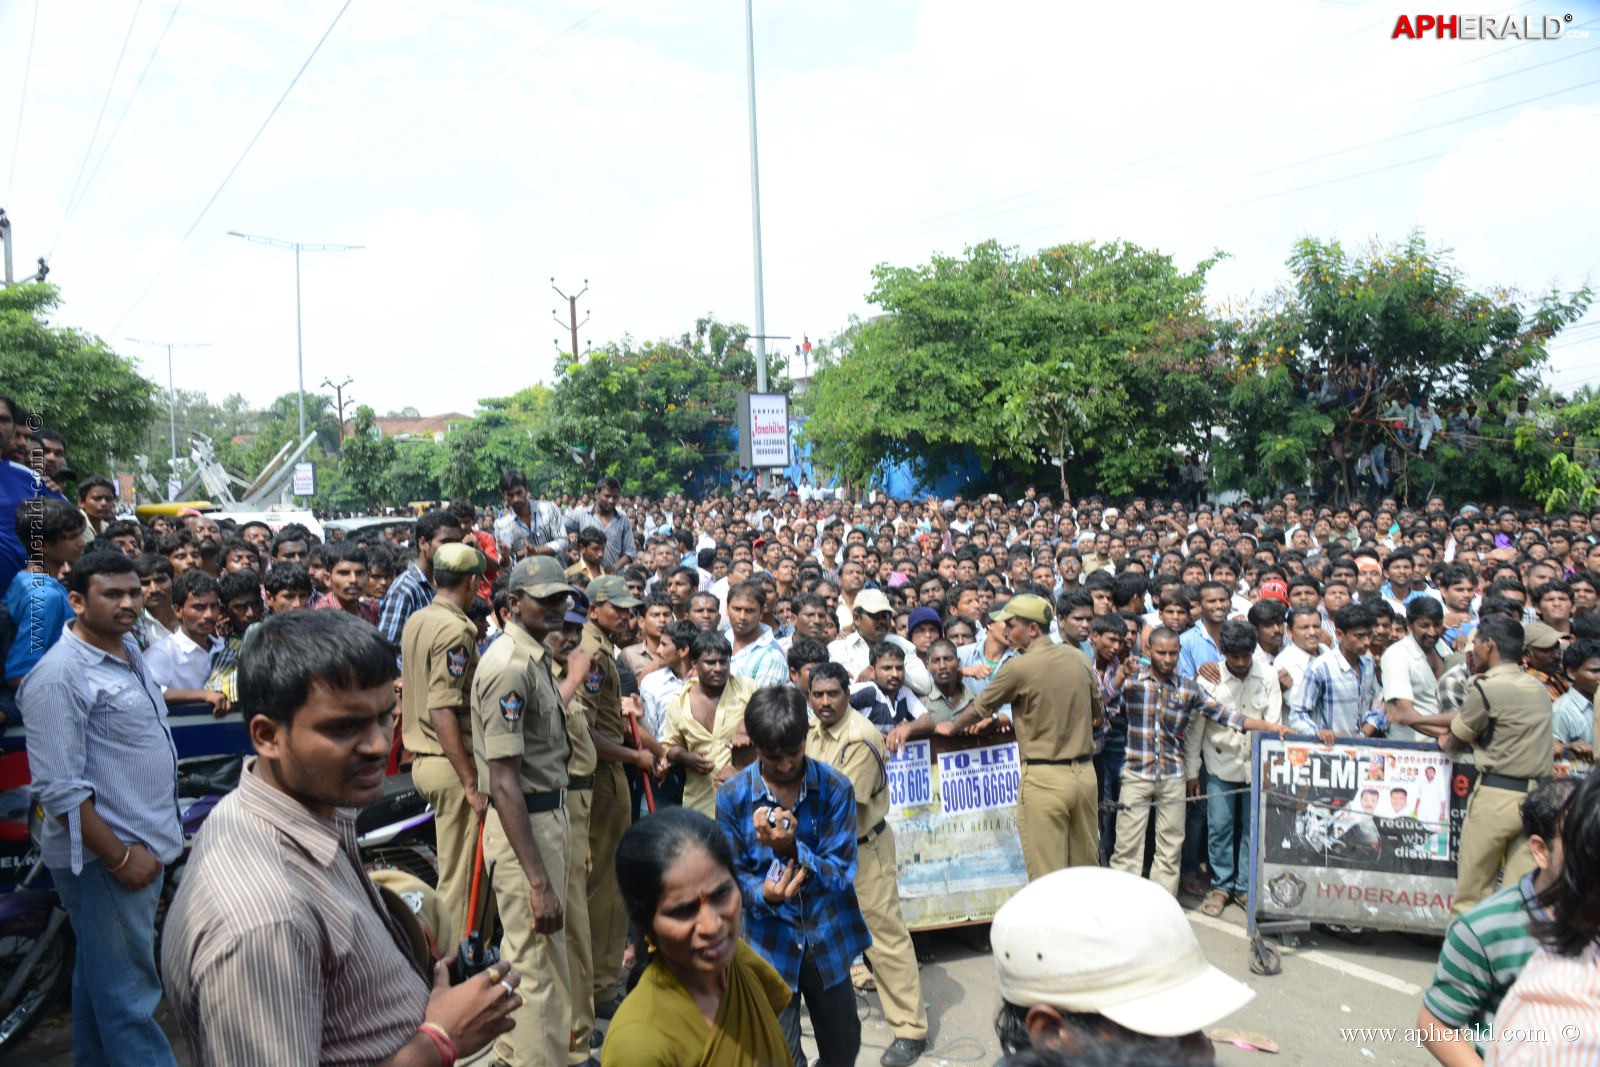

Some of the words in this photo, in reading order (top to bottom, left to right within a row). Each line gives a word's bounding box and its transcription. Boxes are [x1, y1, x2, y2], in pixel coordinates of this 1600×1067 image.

[940, 745, 1017, 772] TO-LET
[907, 767, 930, 803] 605
[943, 776, 982, 813] 90005
